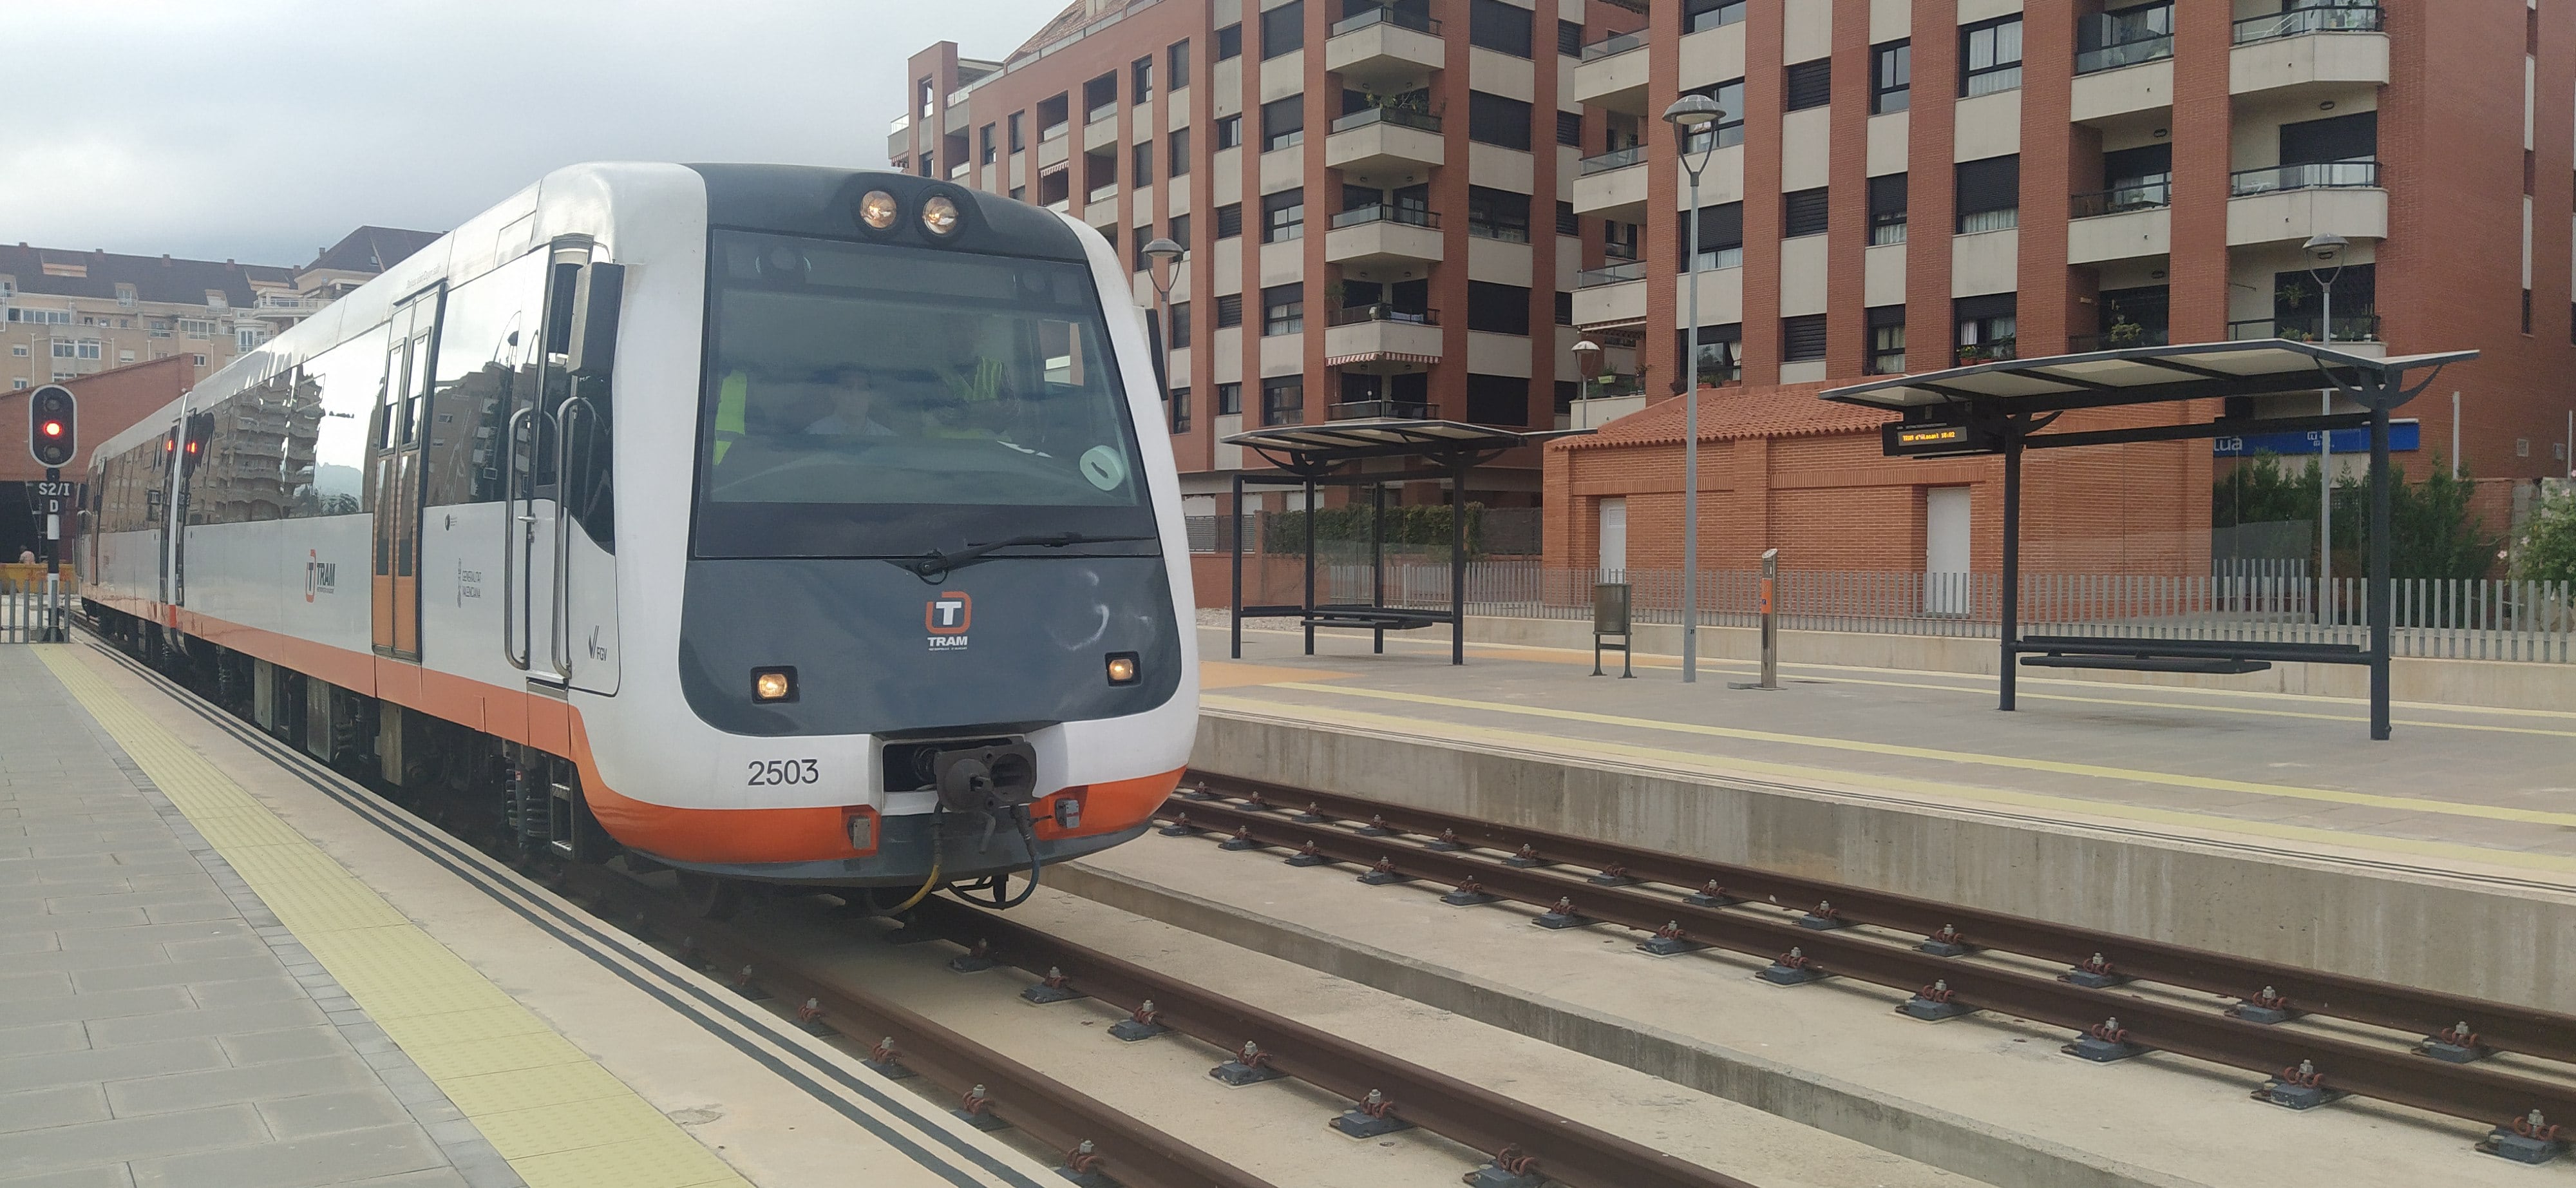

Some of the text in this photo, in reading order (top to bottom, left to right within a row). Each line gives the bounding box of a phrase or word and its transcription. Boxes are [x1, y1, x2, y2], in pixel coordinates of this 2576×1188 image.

[39, 483, 70, 496] S2/I
[50, 499, 59, 512] D
[317, 562, 336, 586] TRAM
[936, 601, 962, 625] T
[927, 636, 968, 646] TRAM
[597, 646, 607, 661] FGV
[748, 759, 819, 785] 2503
